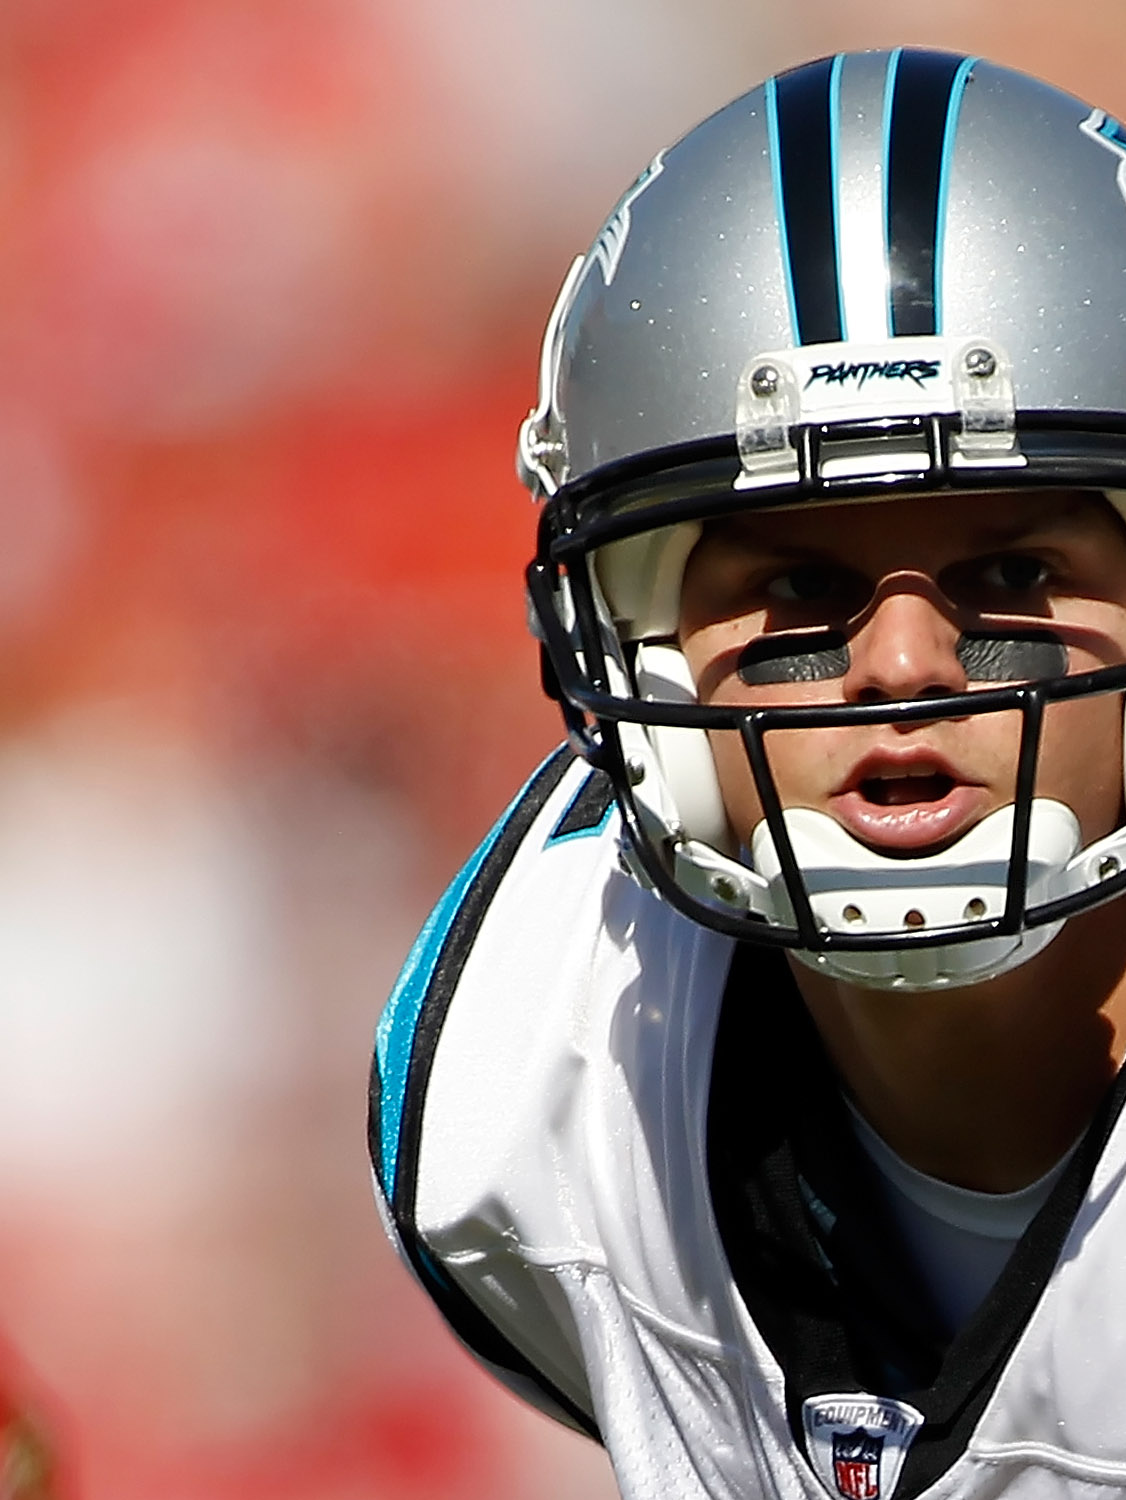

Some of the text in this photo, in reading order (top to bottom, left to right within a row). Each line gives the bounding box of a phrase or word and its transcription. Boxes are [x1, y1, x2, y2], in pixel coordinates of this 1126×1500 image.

[803, 359, 942, 391] PANTHERS
[813, 1404, 910, 1436] EQUIPMENT
[836, 1461, 878, 1500] NFL
